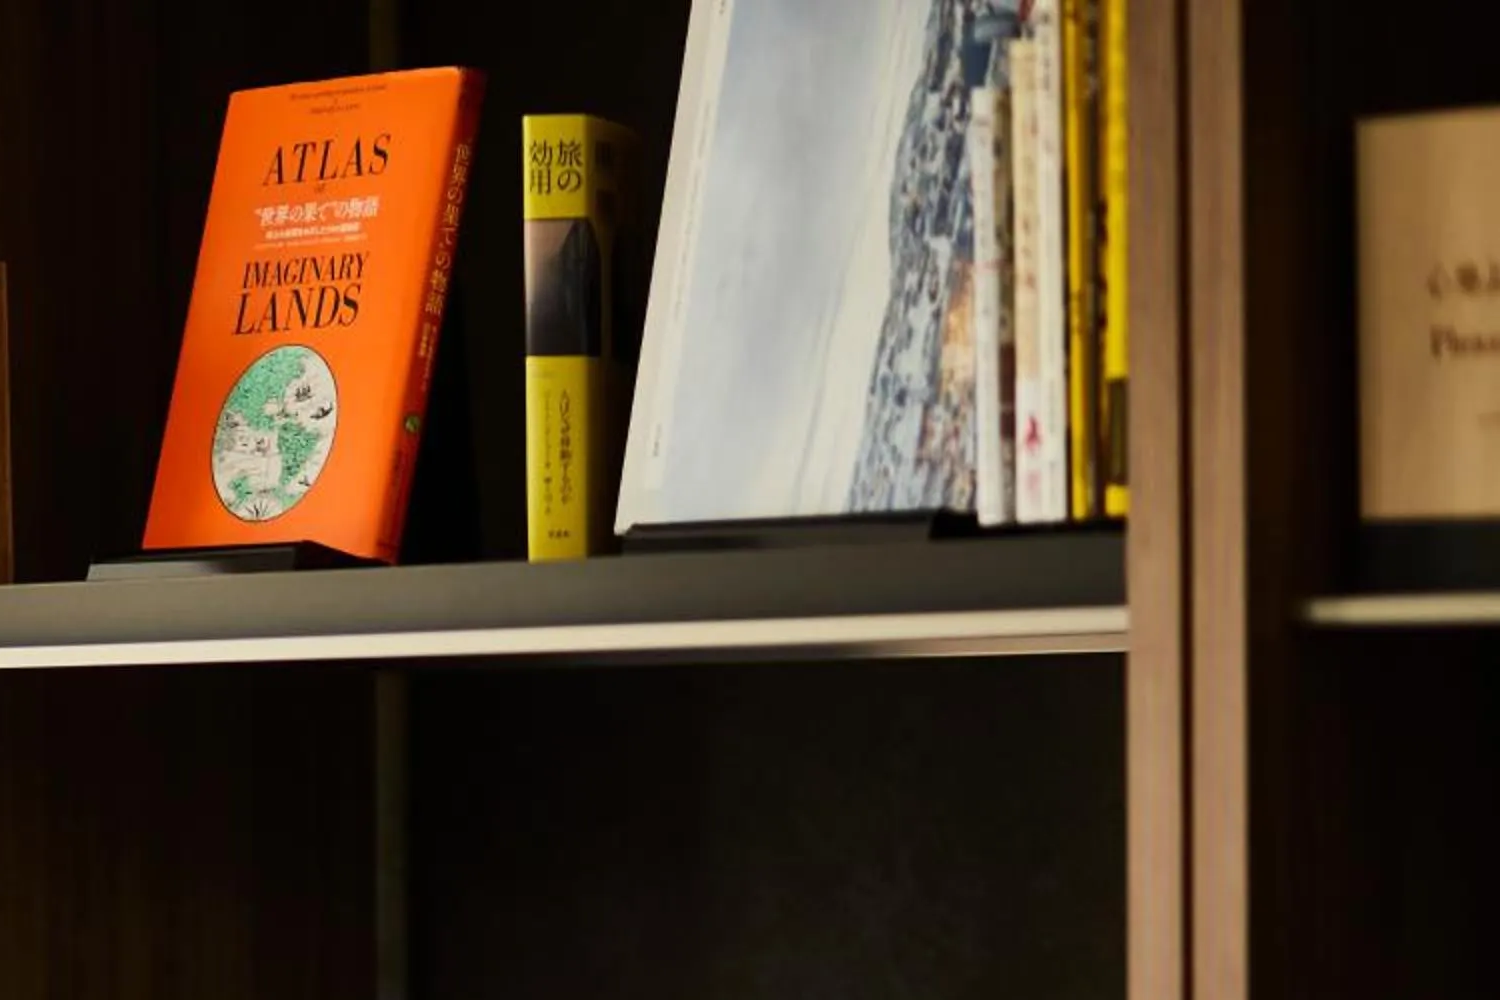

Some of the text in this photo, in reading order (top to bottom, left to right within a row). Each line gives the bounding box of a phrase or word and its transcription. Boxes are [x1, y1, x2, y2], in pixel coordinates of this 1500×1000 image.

[263, 133, 390, 186] ATLAS
[243, 252, 369, 289] IMAGINARY
[233, 284, 361, 336] LANDS
